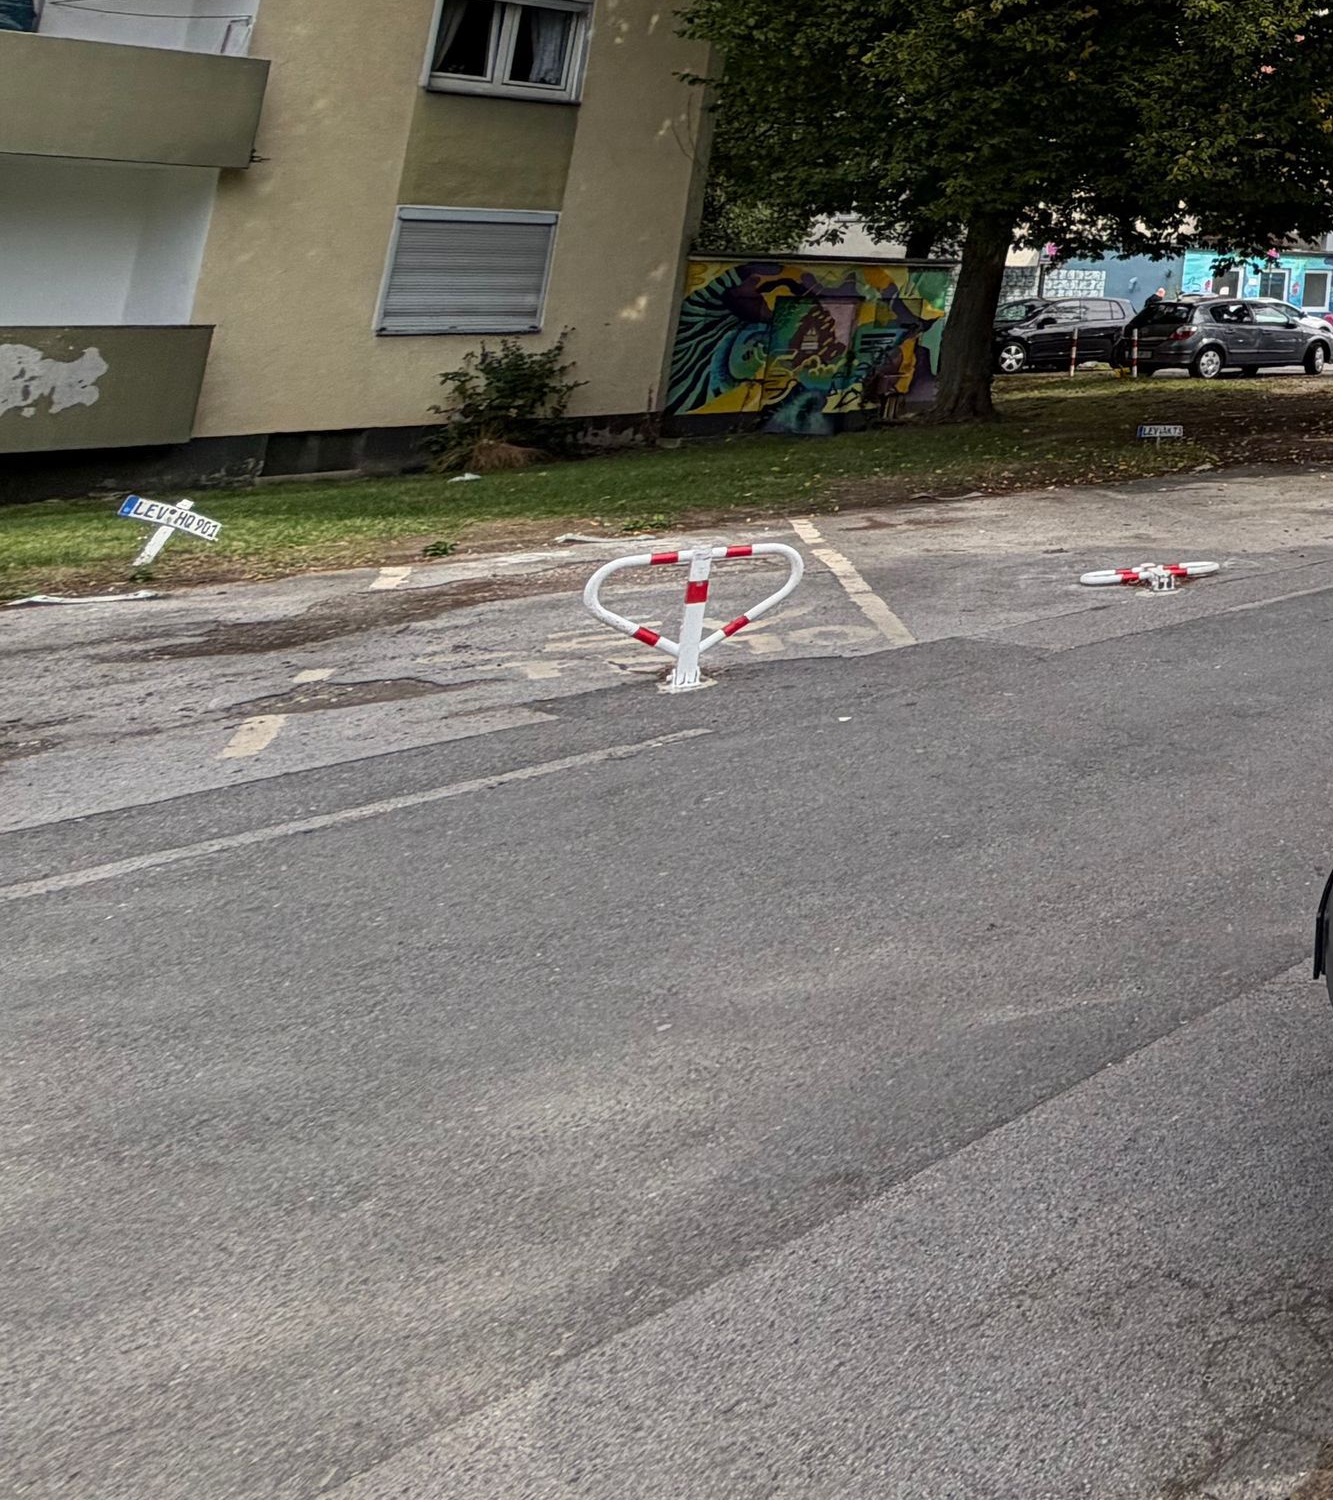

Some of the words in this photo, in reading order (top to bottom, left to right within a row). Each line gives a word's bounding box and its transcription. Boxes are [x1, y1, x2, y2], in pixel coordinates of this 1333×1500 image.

[133, 501, 169, 520] LEV
[174, 511, 196, 528] HQ
[194, 518, 218, 538] 901
